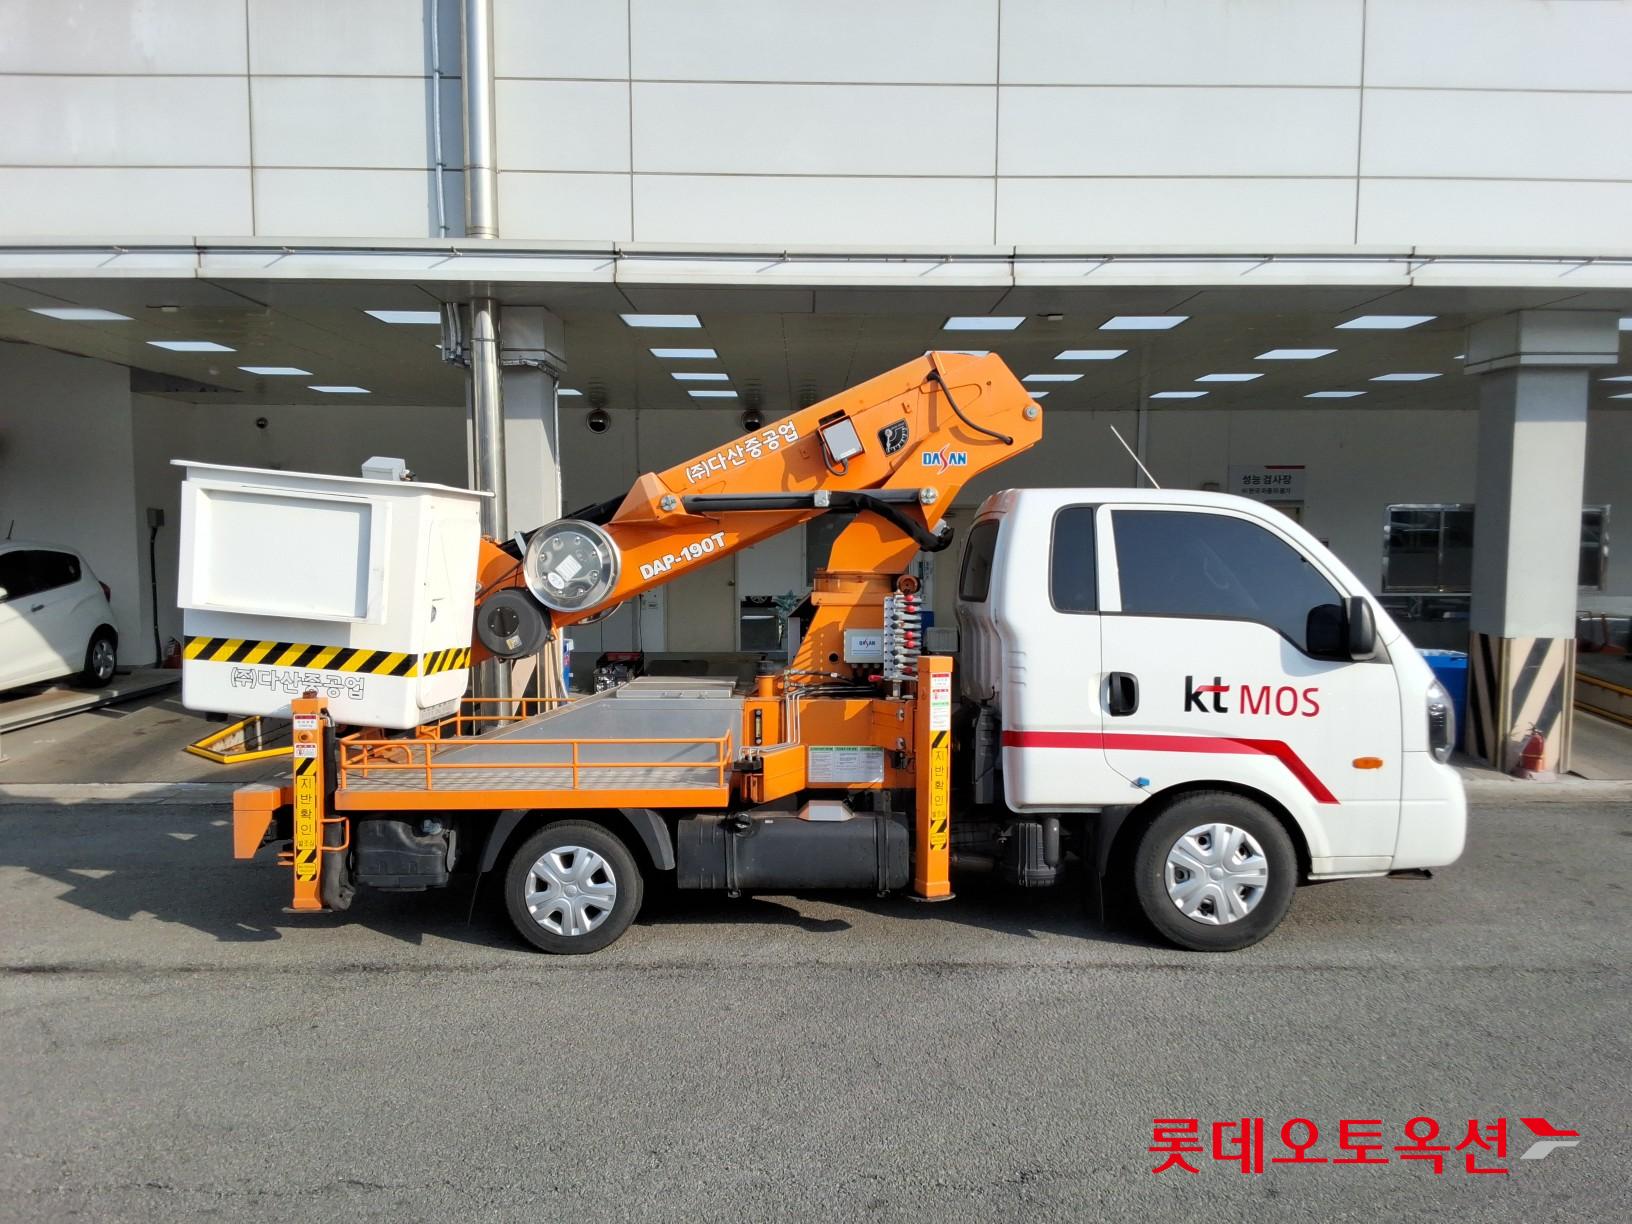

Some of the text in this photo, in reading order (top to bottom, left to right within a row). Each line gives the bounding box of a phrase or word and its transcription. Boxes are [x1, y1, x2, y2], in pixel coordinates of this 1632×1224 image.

[686, 420, 799, 484] (주)다산중공업
[922, 444, 967, 472] DASAN
[1242, 475, 1292, 485] 성능 검사장
[639, 530, 725, 580] DAP-190T
[231, 667, 365, 700] (주)다산중공업
[1184, 675, 1321, 718] kt MOS
